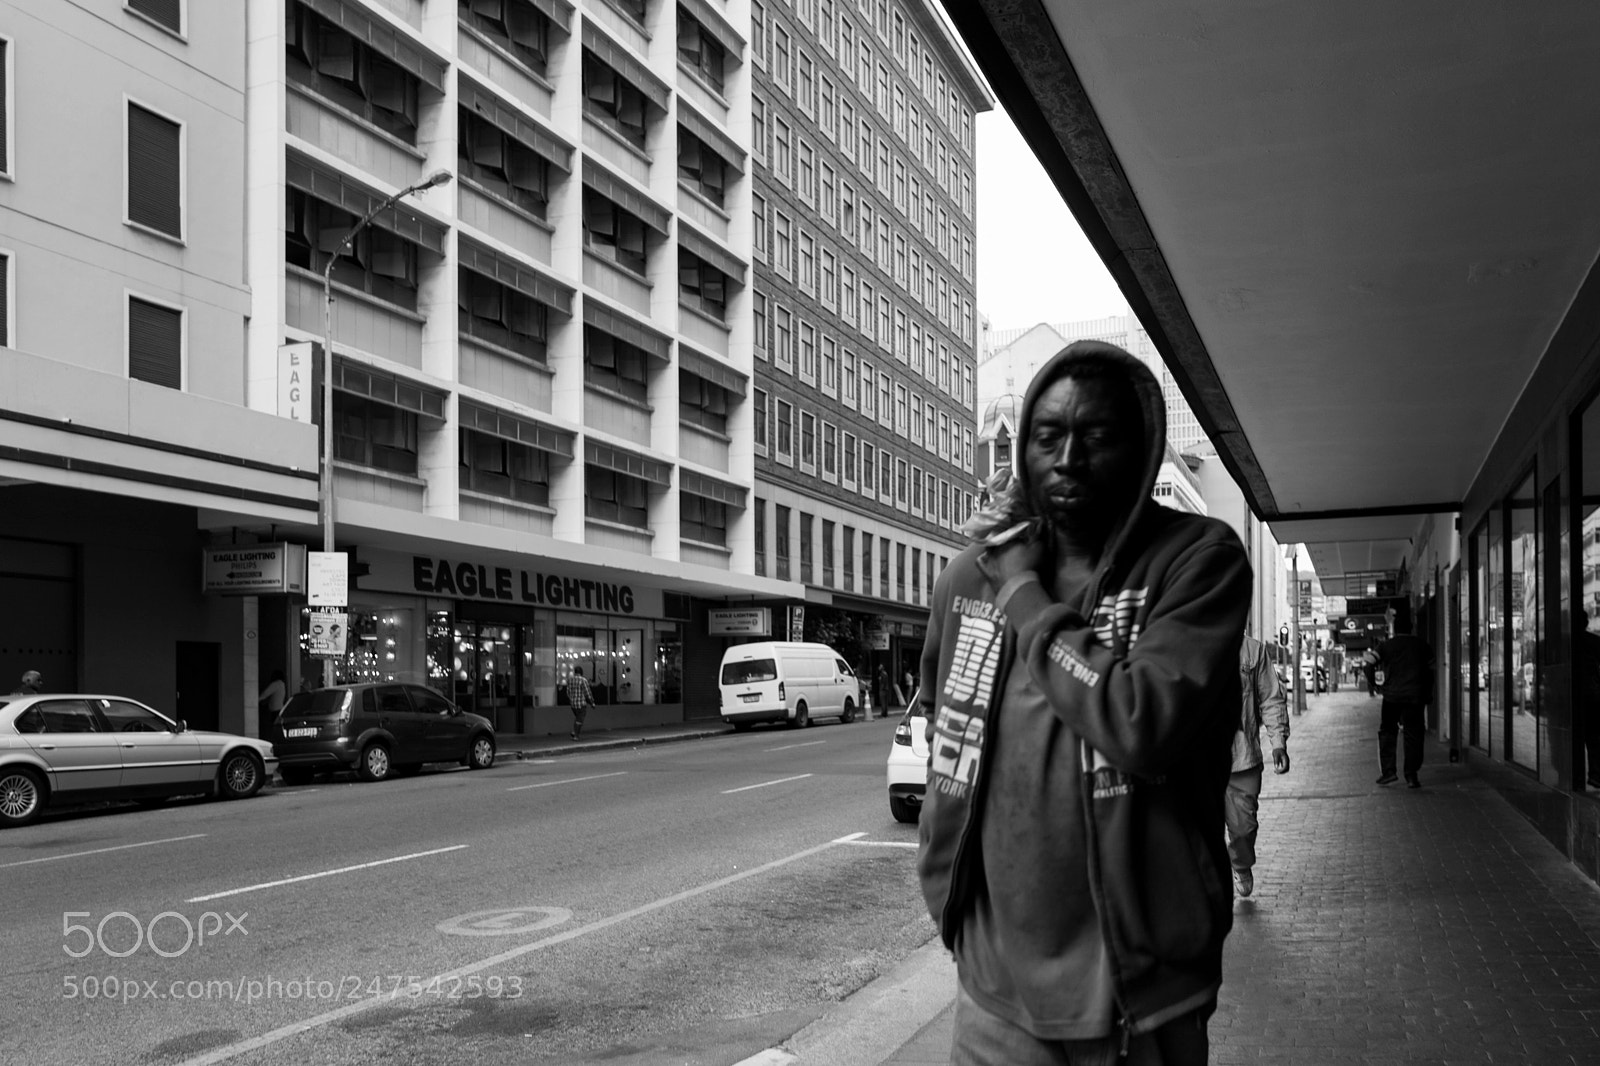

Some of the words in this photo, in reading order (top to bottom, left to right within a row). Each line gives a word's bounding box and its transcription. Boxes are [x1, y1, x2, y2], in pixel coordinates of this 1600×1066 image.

[213, 553, 238, 562] EAGLE
[240, 552, 276, 561] LIGHTING
[231, 561, 257, 570] PHILIPS
[412, 556, 513, 600] EAGLE
[520, 571, 634, 614] LIGHTING
[1302, 582, 1309, 590] P
[934, 775, 968, 799] YORK
